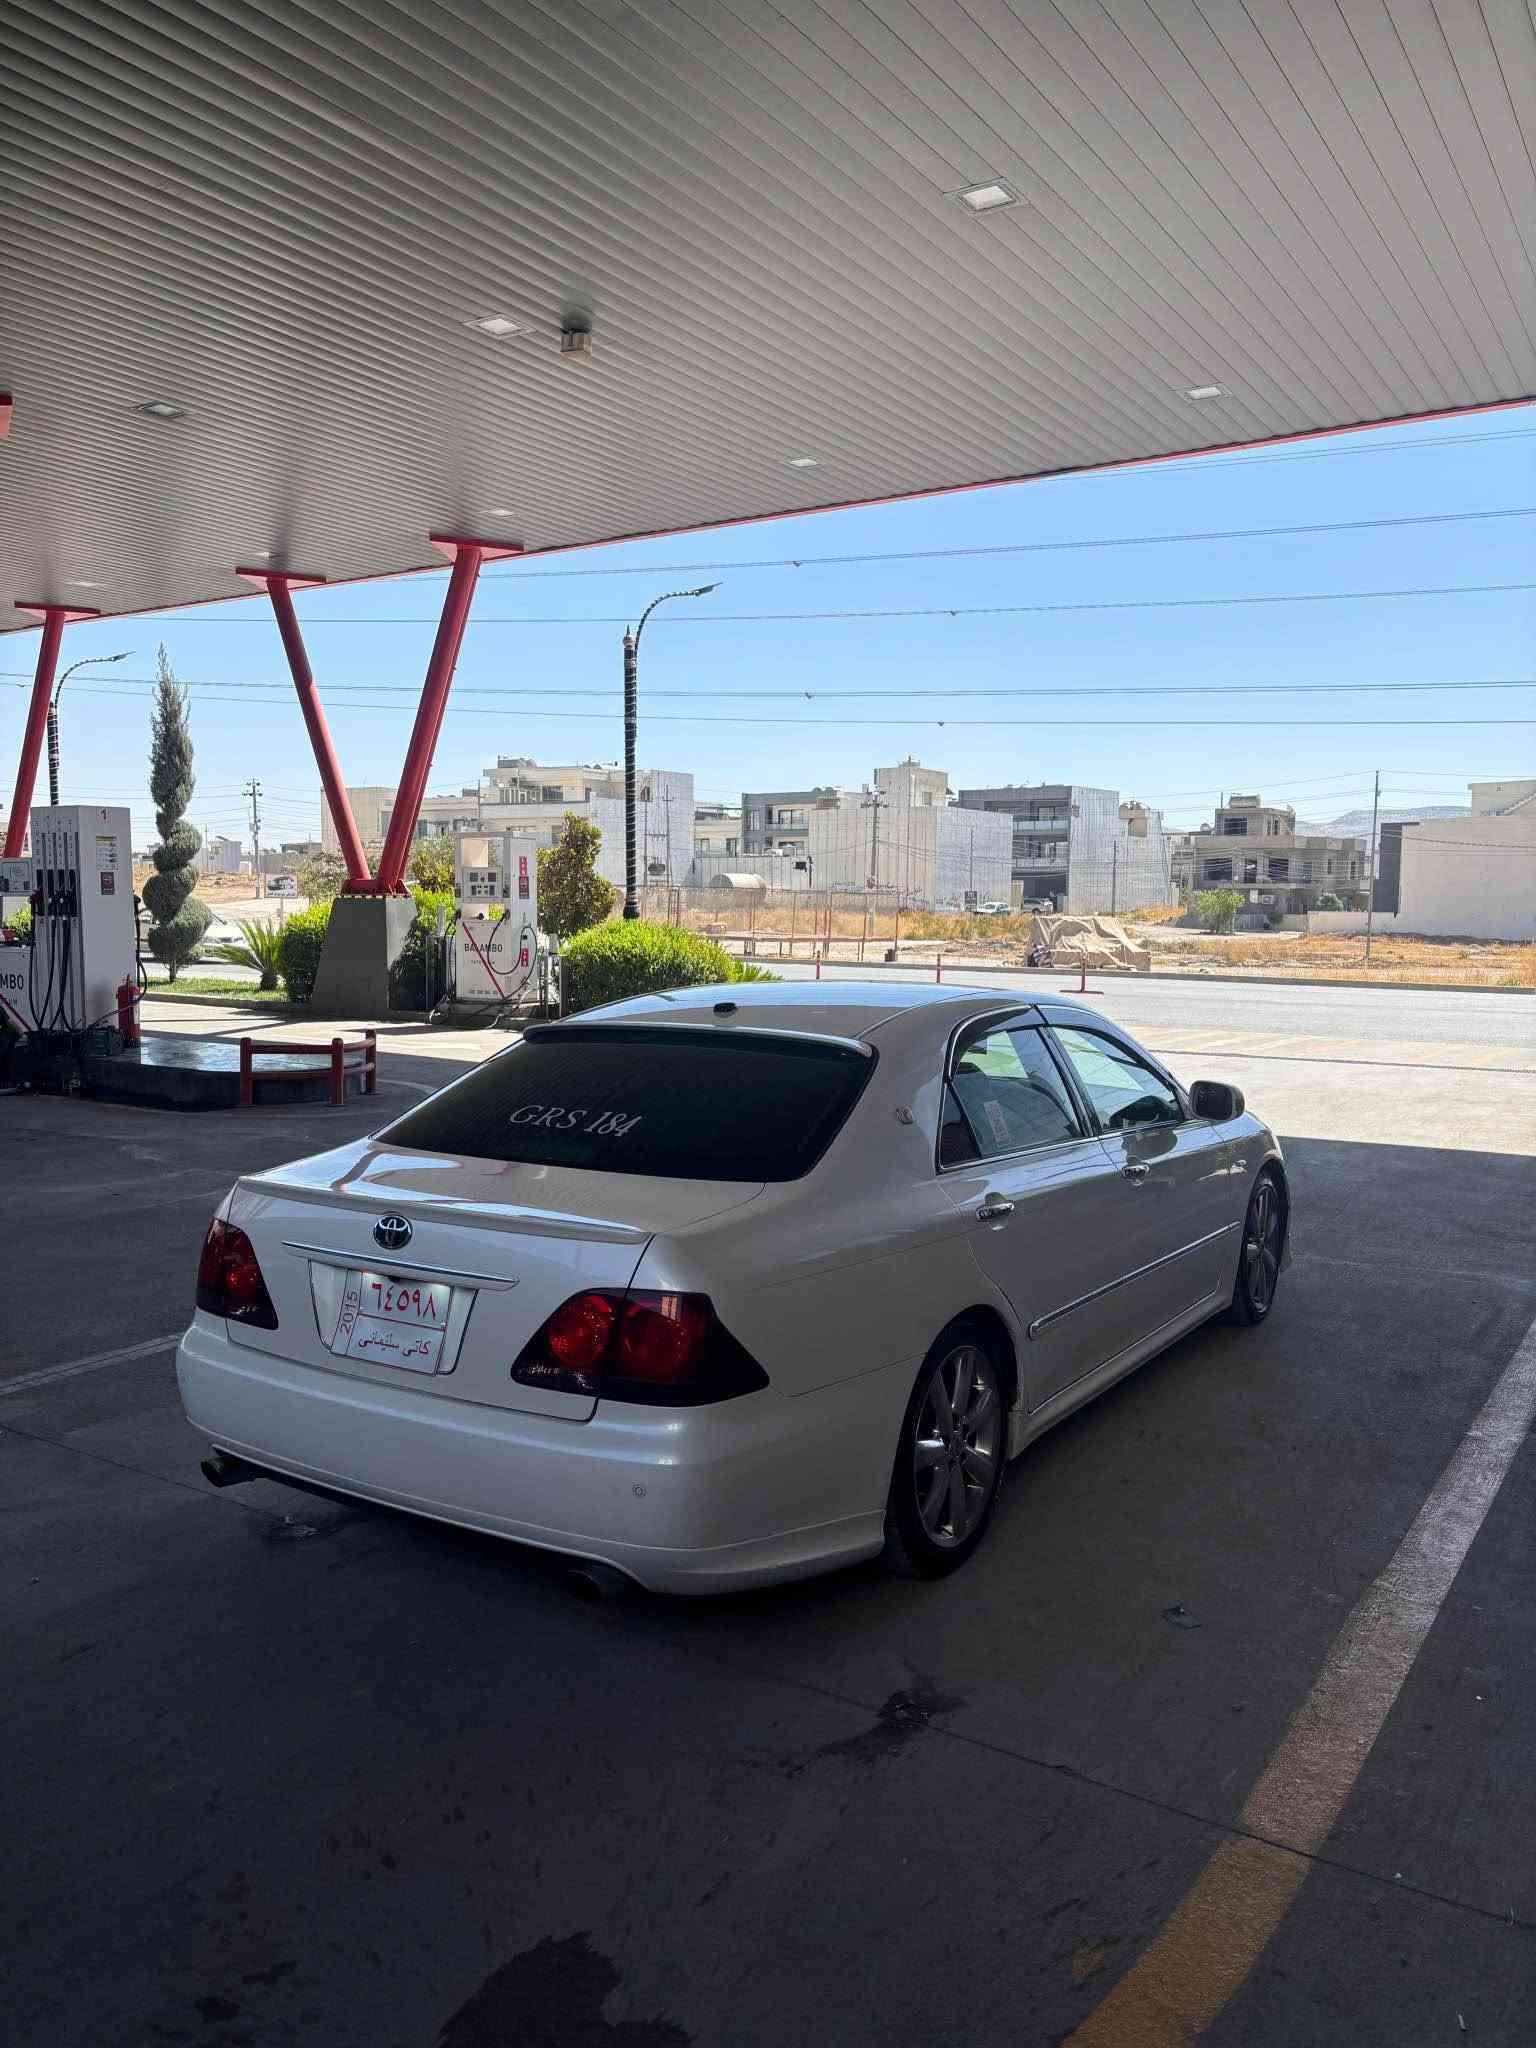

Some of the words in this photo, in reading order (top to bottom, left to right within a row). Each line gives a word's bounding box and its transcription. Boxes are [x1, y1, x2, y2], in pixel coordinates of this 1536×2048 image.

[464, 943, 503, 953] BAAMBO
[510, 1104, 587, 1129] GRS
[584, 1111, 642, 1137] 184
[342, 1291, 358, 1334] 2015
[370, 1283, 437, 1321] ٦٤٥٩٨
